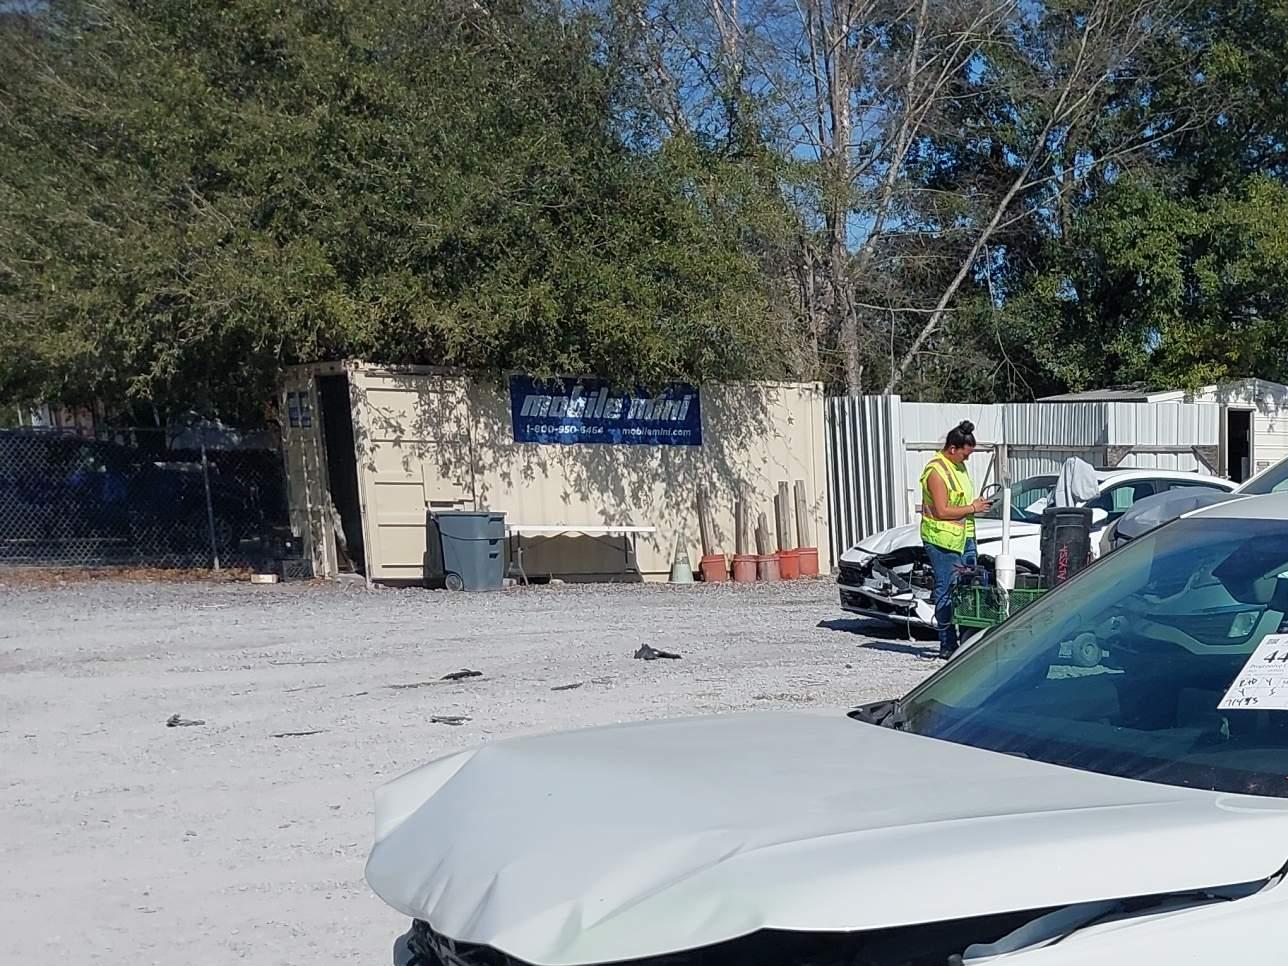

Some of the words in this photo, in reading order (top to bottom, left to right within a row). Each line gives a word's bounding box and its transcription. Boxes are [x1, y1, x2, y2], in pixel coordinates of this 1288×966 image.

[520, 386, 624, 419] mobile
[626, 393, 693, 421] mini
[621, 427, 692, 437] mobilemini.com
